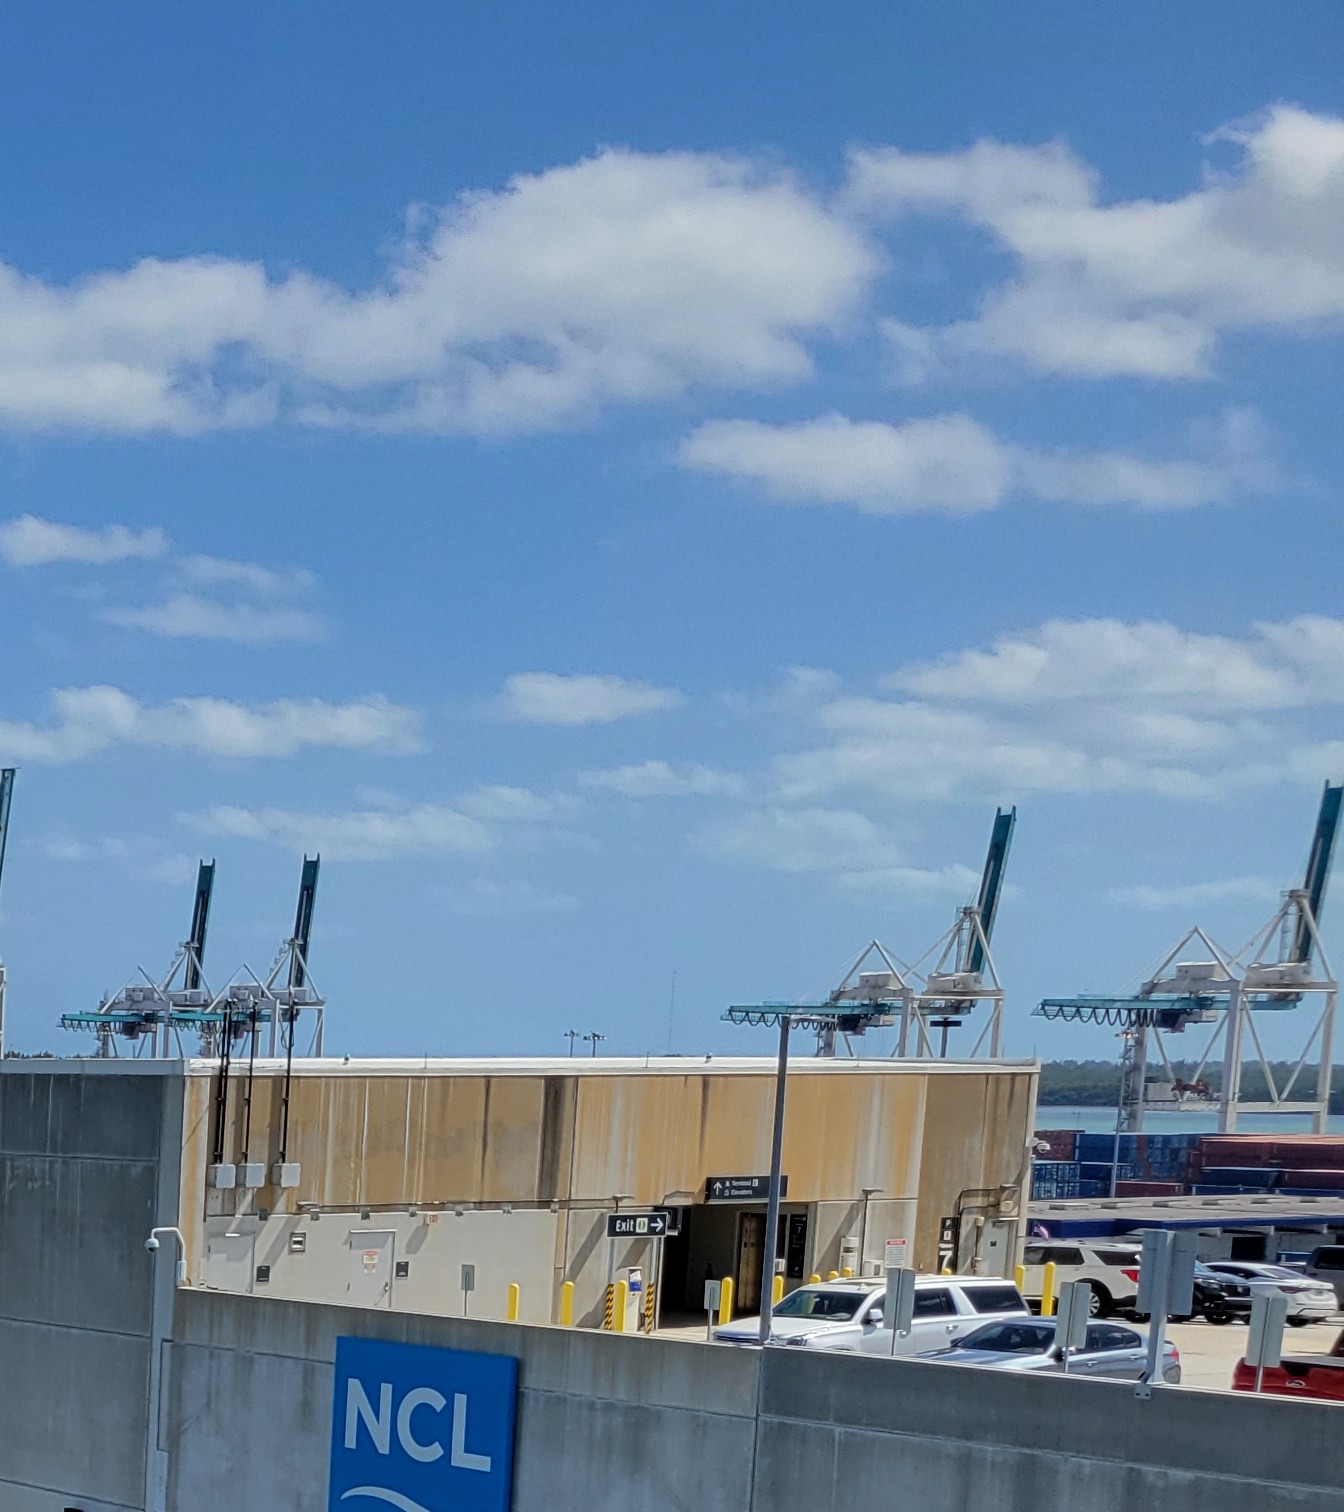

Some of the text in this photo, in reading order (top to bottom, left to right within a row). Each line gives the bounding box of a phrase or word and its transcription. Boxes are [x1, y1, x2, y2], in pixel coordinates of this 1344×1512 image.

[615, 1218, 634, 1232] Exit
[938, 1250, 952, 1271] 7
[342, 1376, 491, 1473] NCL
